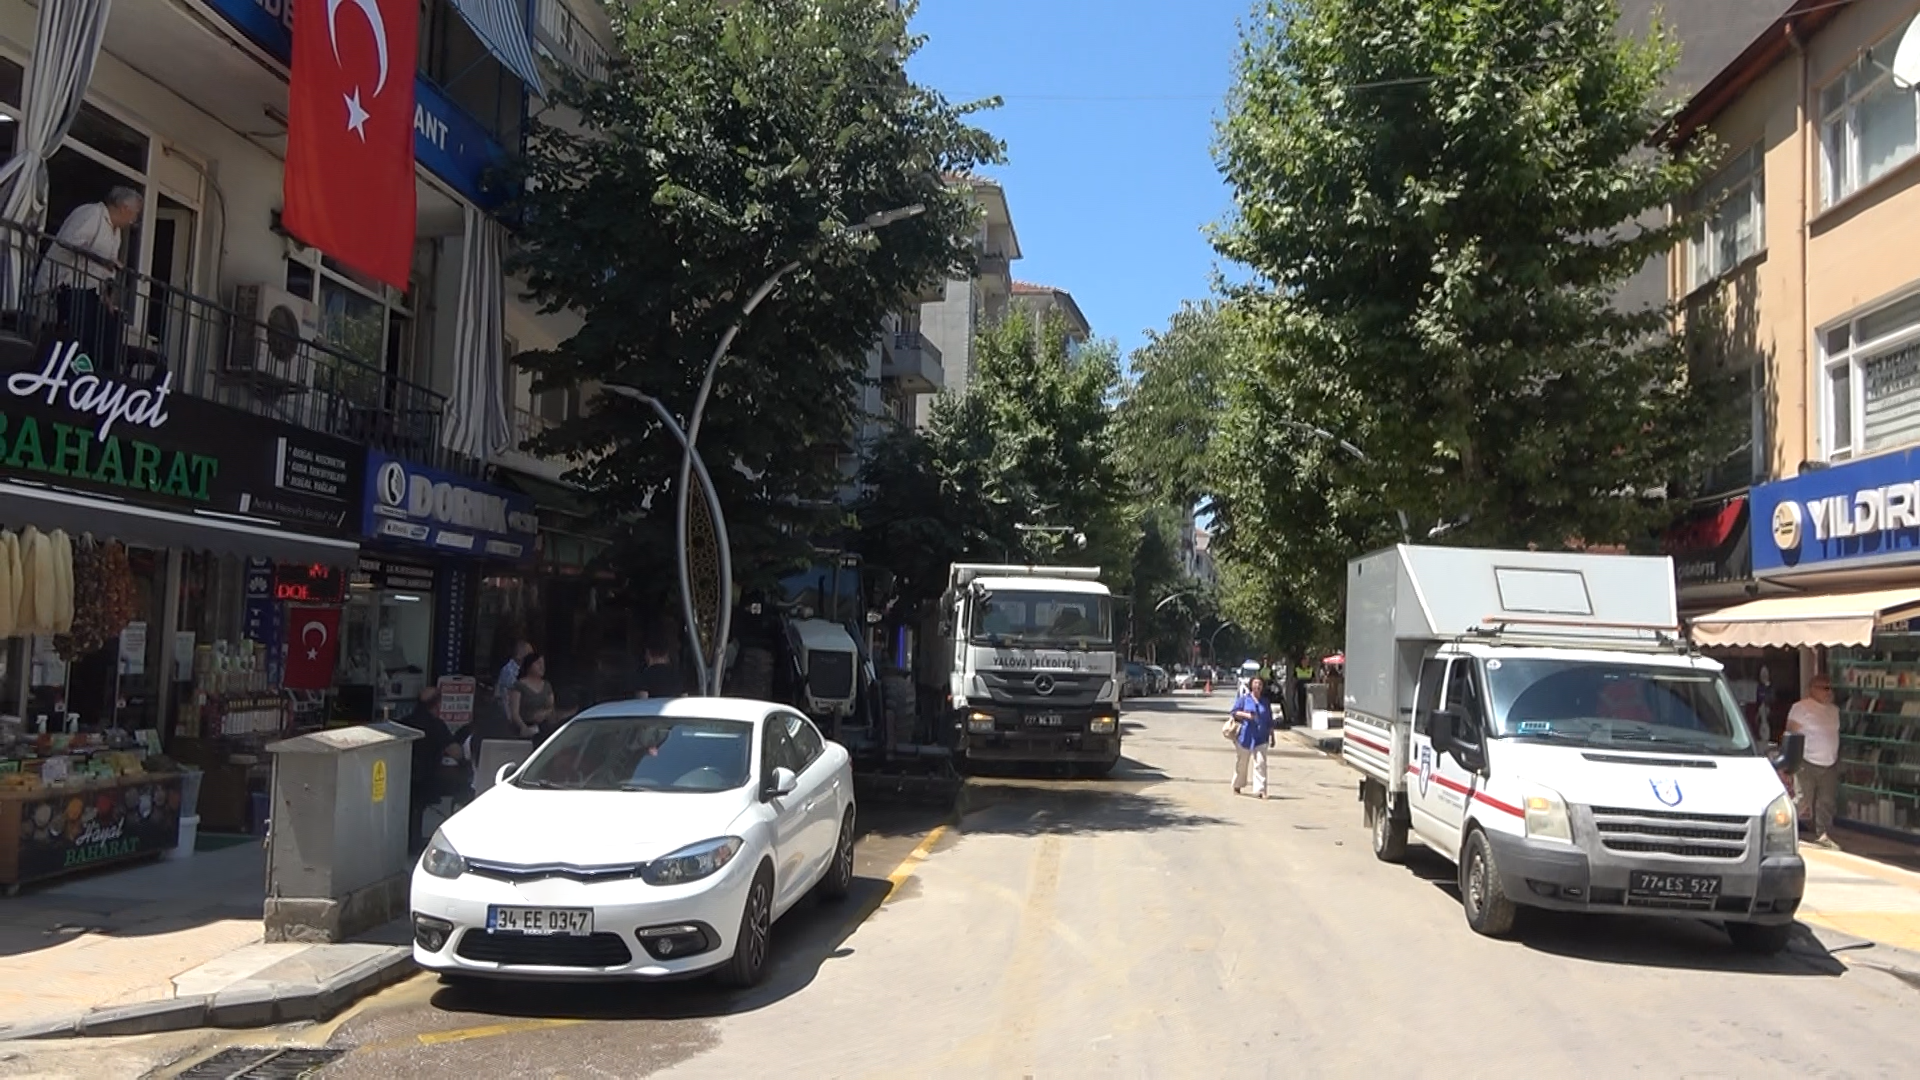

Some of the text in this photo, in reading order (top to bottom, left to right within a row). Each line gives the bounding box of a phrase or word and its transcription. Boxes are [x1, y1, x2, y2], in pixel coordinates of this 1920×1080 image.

[7, 341, 173, 442] Hayat
[0, 411, 219, 500] AHARAT
[993, 657, 1027, 668] YALOVA
[64, 836, 141, 867] BAHARAT
[1641, 874, 1718, 893] 77 ES 527
[499, 910, 588, 931] 34 EE 0347
